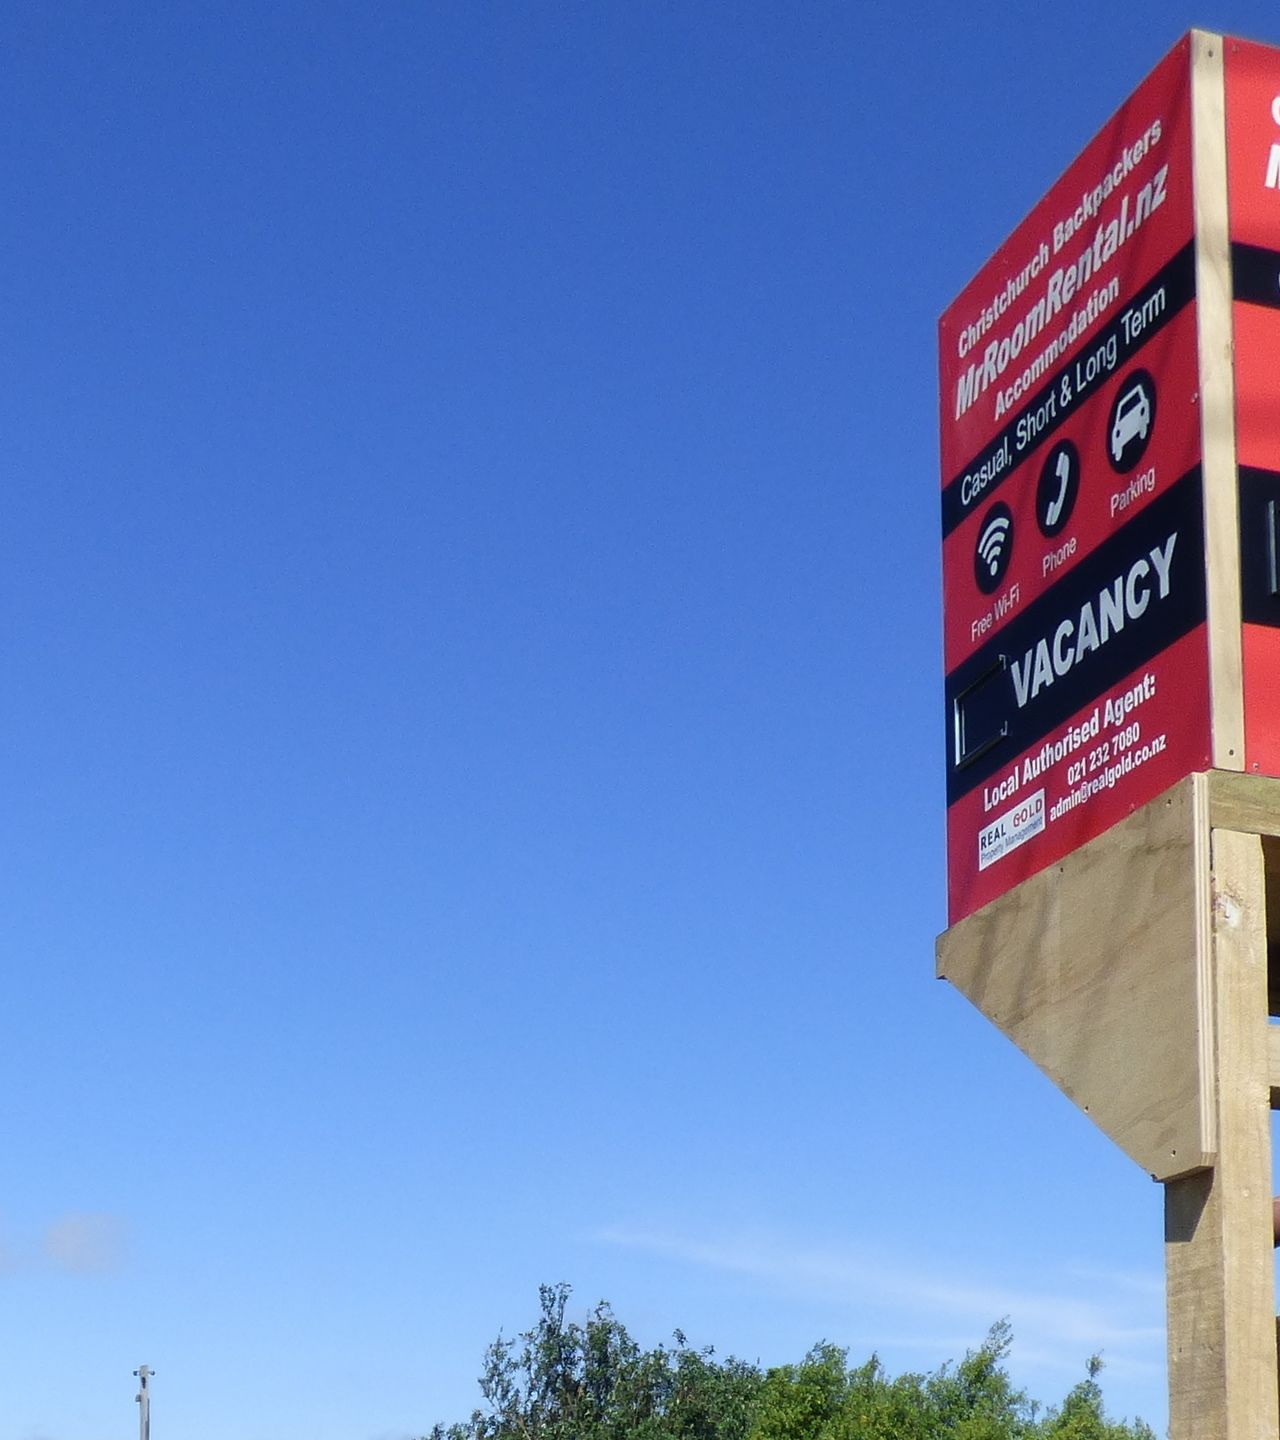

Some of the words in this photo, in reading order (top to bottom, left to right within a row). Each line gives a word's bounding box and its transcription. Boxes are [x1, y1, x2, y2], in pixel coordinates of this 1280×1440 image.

[955, 164, 1169, 421] MrRoomRental.nz
[958, 242, 1049, 358] Christchurch
[1052, 119, 1161, 255] Backpackers
[961, 436, 1012, 505] Casual,
[1016, 390, 1056, 450] Short
[1060, 375, 1072, 407] &
[1076, 334, 1117, 392] Long
[1121, 287, 1166, 345] Term
[994, 276, 1119, 421] Accommodation
[1110, 467, 1156, 518] Parking
[971, 614, 992, 642] Free
[993, 583, 1020, 622] Wi-Fi
[1042, 537, 1077, 578] Phone
[1010, 532, 1178, 708] VACANCY
[984, 766, 1019, 812] Local
[1022, 708, 1099, 785] Authorised
[1103, 673, 1155, 728] Agent:
[1050, 734, 1167, 822] admin@realgold.co.nz
[1067, 758, 1086, 786] 021
[1089, 742, 1109, 772] 232
[1112, 722, 1140, 756] 7080
[980, 823, 1007, 850] REAL
[1012, 798, 1042, 828] GOLD
